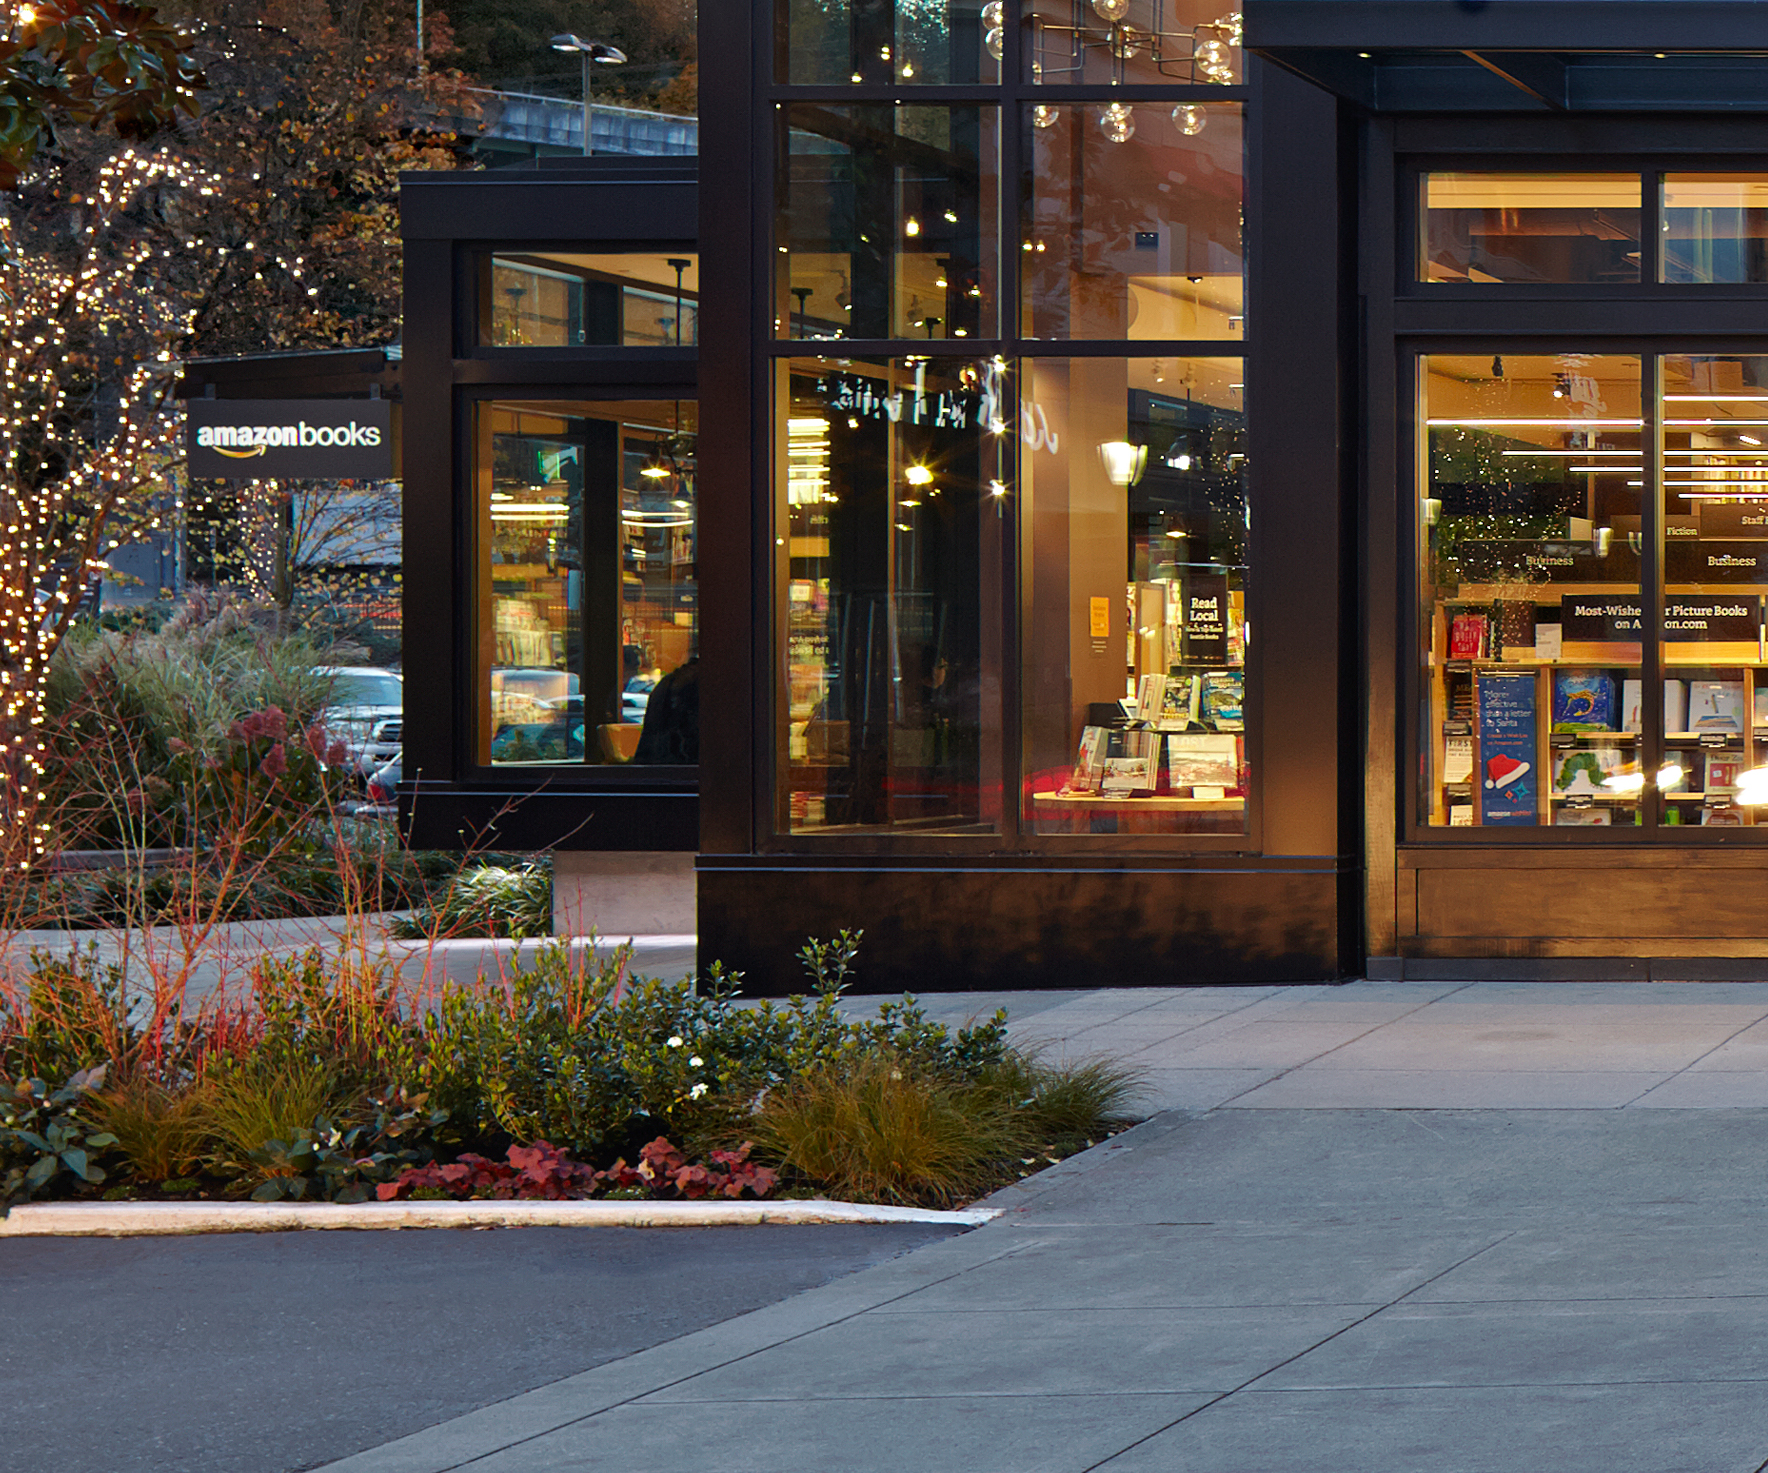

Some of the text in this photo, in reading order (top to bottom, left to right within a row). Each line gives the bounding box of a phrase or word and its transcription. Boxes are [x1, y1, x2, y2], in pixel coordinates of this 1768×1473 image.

[197, 420, 382, 447] amazonbooks
[1667, 527, 1697, 536] Fiction
[1526, 555, 1573, 566] Business
[1708, 555, 1757, 566] Business
[1191, 597, 1217, 609] Read
[1190, 610, 1219, 622] Local
[1672, 605, 1713, 616] Picture
[1714, 605, 1748, 616] Books
[1615, 620, 1630, 629] on
